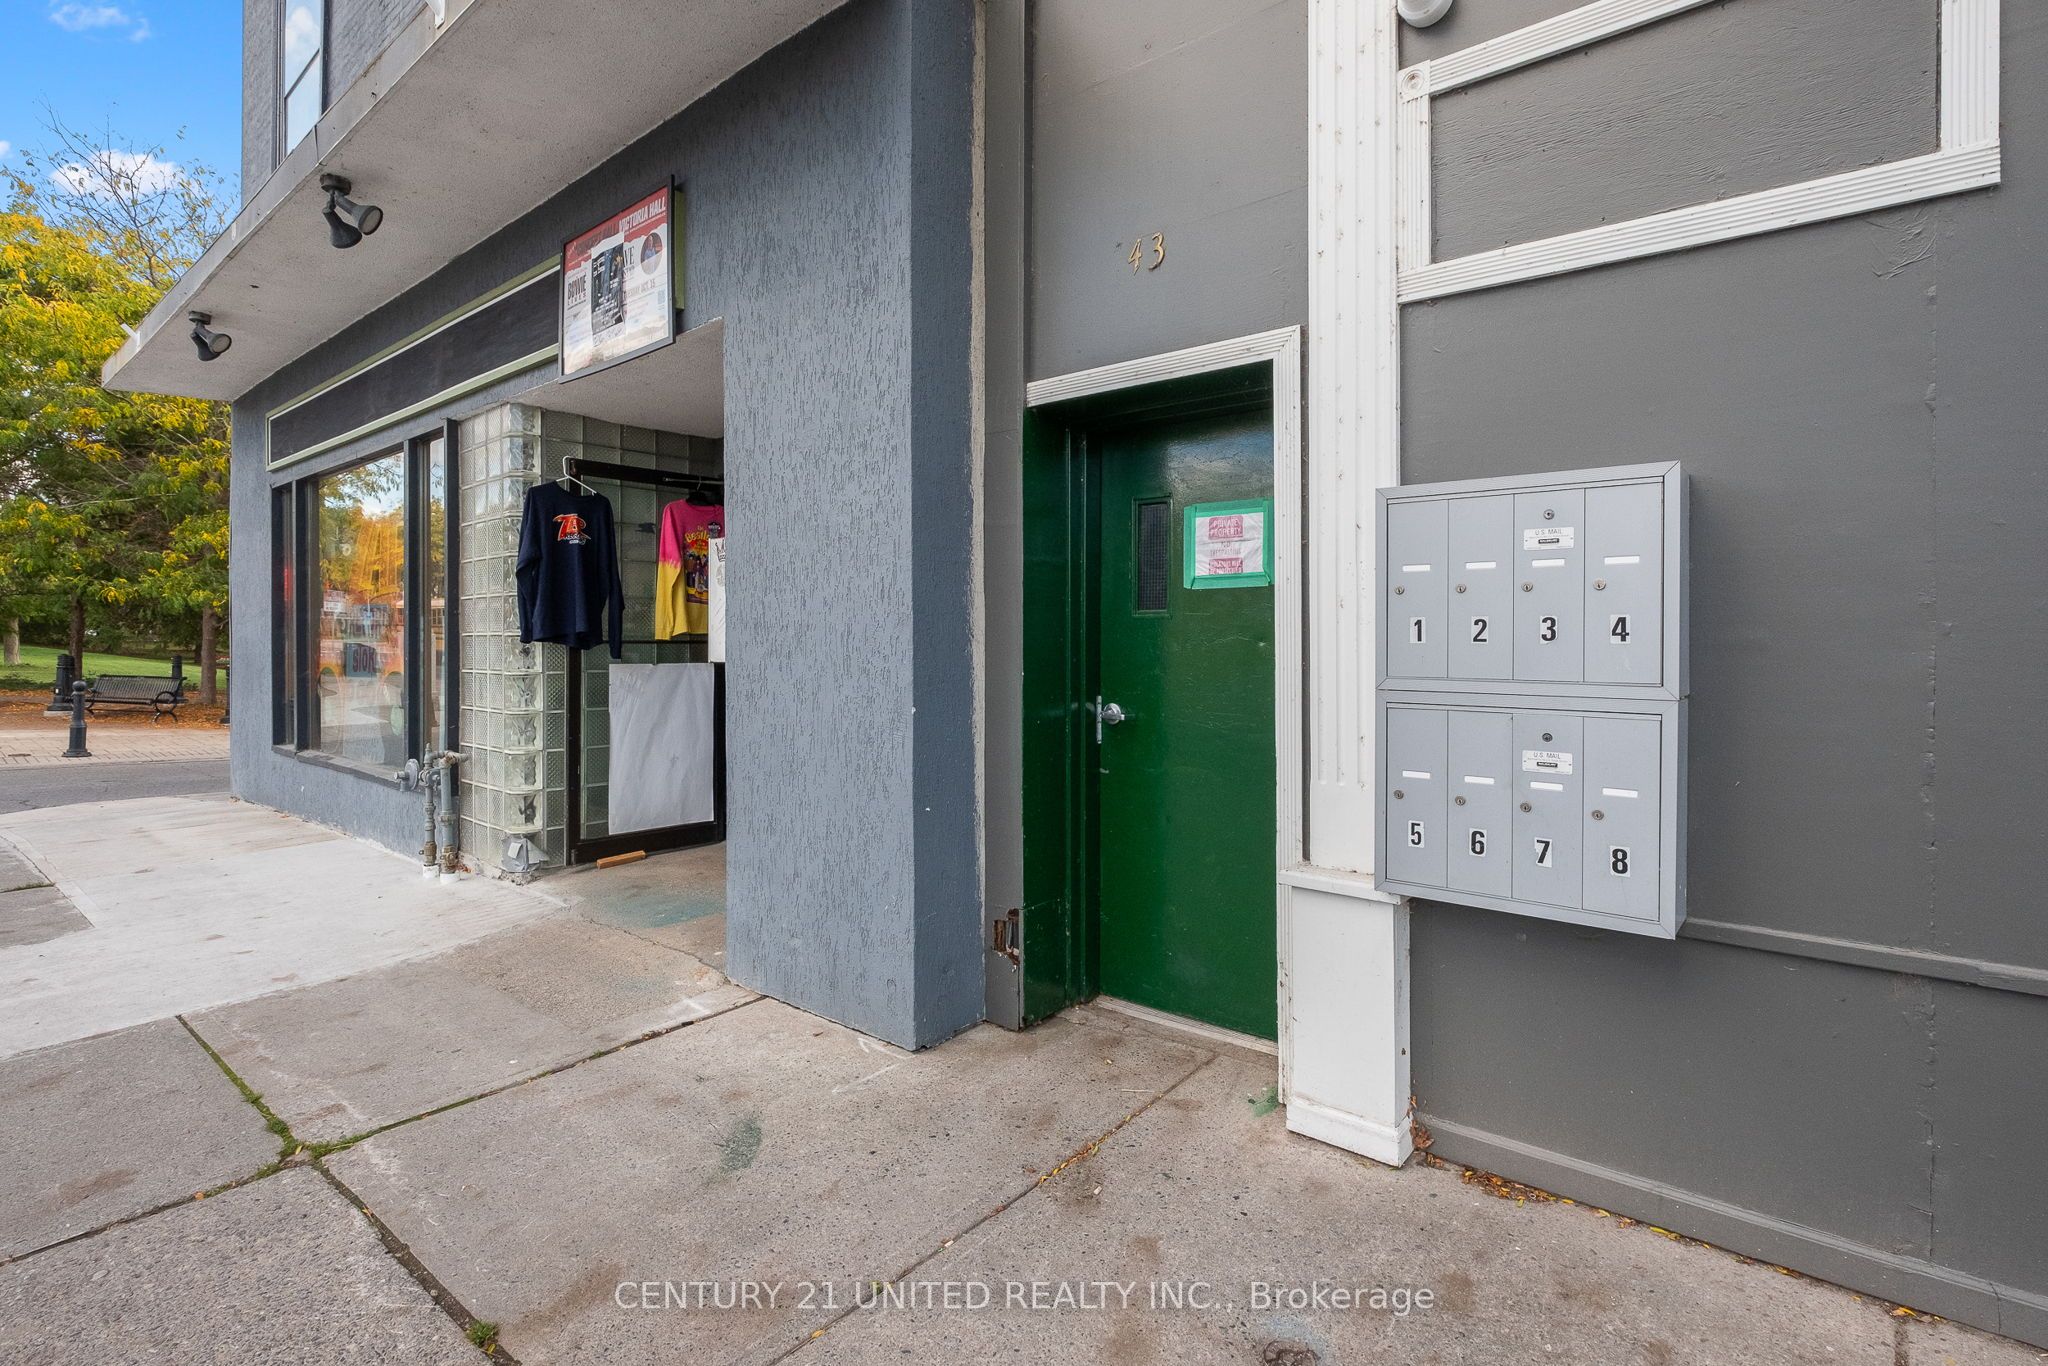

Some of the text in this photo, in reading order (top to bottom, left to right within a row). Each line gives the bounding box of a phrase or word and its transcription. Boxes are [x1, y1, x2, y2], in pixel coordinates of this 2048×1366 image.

[619, 205, 649, 232] VICTORIA
[649, 196, 666, 218] HALL
[1128, 232, 1165, 276] 43
[1210, 527, 1241, 538] PROPERTY
[1213, 517, 1240, 528] PRIVATE
[1414, 619, 1422, 642] 1
[1473, 618, 1487, 643] 2
[1541, 616, 1557, 642] 3
[1611, 616, 1629, 642] 4
[1411, 822, 1422, 846] 5
[1471, 830, 1485, 855] 6
[1536, 839, 1551, 864] 7
[1611, 848, 1628, 874] 8
